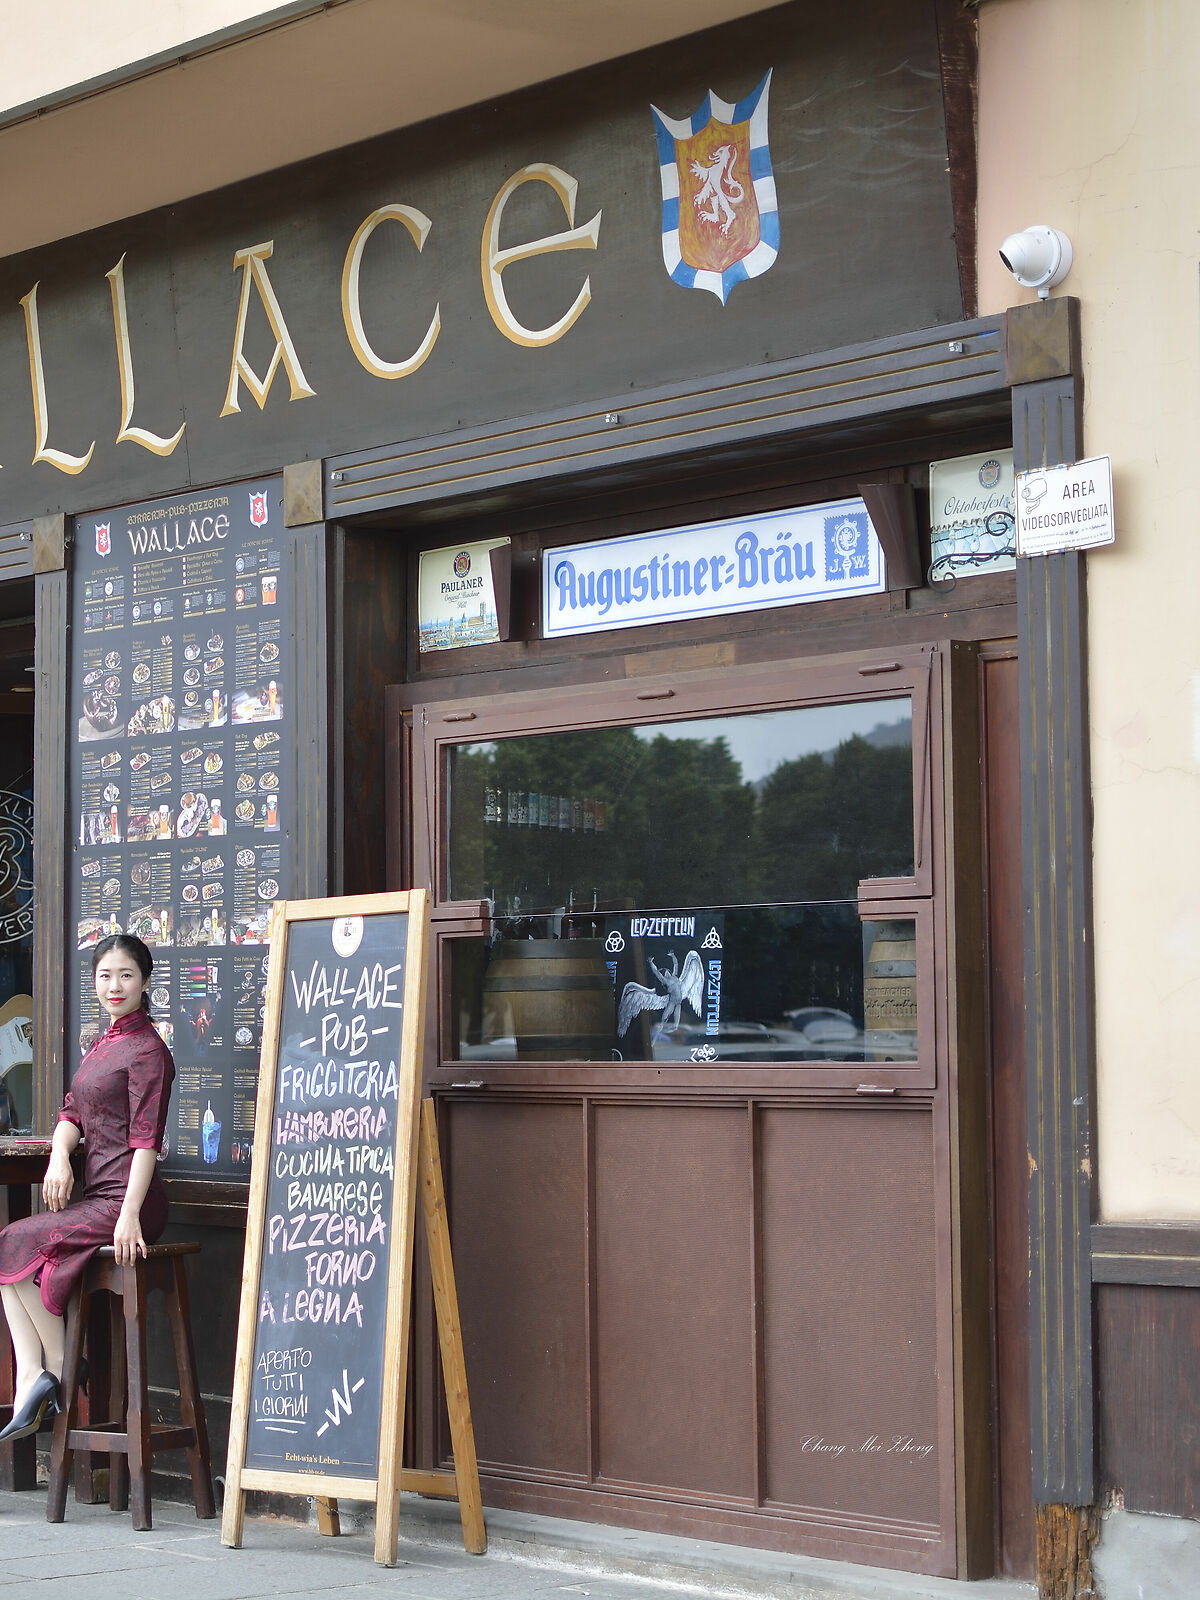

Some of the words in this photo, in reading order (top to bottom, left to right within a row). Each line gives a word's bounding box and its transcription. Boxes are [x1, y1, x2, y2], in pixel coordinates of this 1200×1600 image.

[943, 491, 1005, 517] Oktoberfest
[1062, 479, 1096, 500] AREA
[127, 513, 231, 556] WALLACE
[1021, 503, 1109, 531] VIDEOSORVEGLIATA
[441, 576, 484, 594] PAULANER
[290, 959, 403, 1014] WALLACE
[279, 1059, 400, 1104] FRIGGITORIA
[275, 1144, 345, 1179] CUCINA
[346, 1145, 394, 1180] TIPICA
[287, 1180, 383, 1217] BAVARESE
[268, 1212, 387, 1254] PIZZERIA
[304, 1250, 376, 1288] FORNO
[281, 1288, 364, 1328] LEGNA
[257, 1347, 313, 1374] APERTO
[261, 1372, 304, 1391] TUTTI
[262, 1394, 309, 1418] GIORNI
